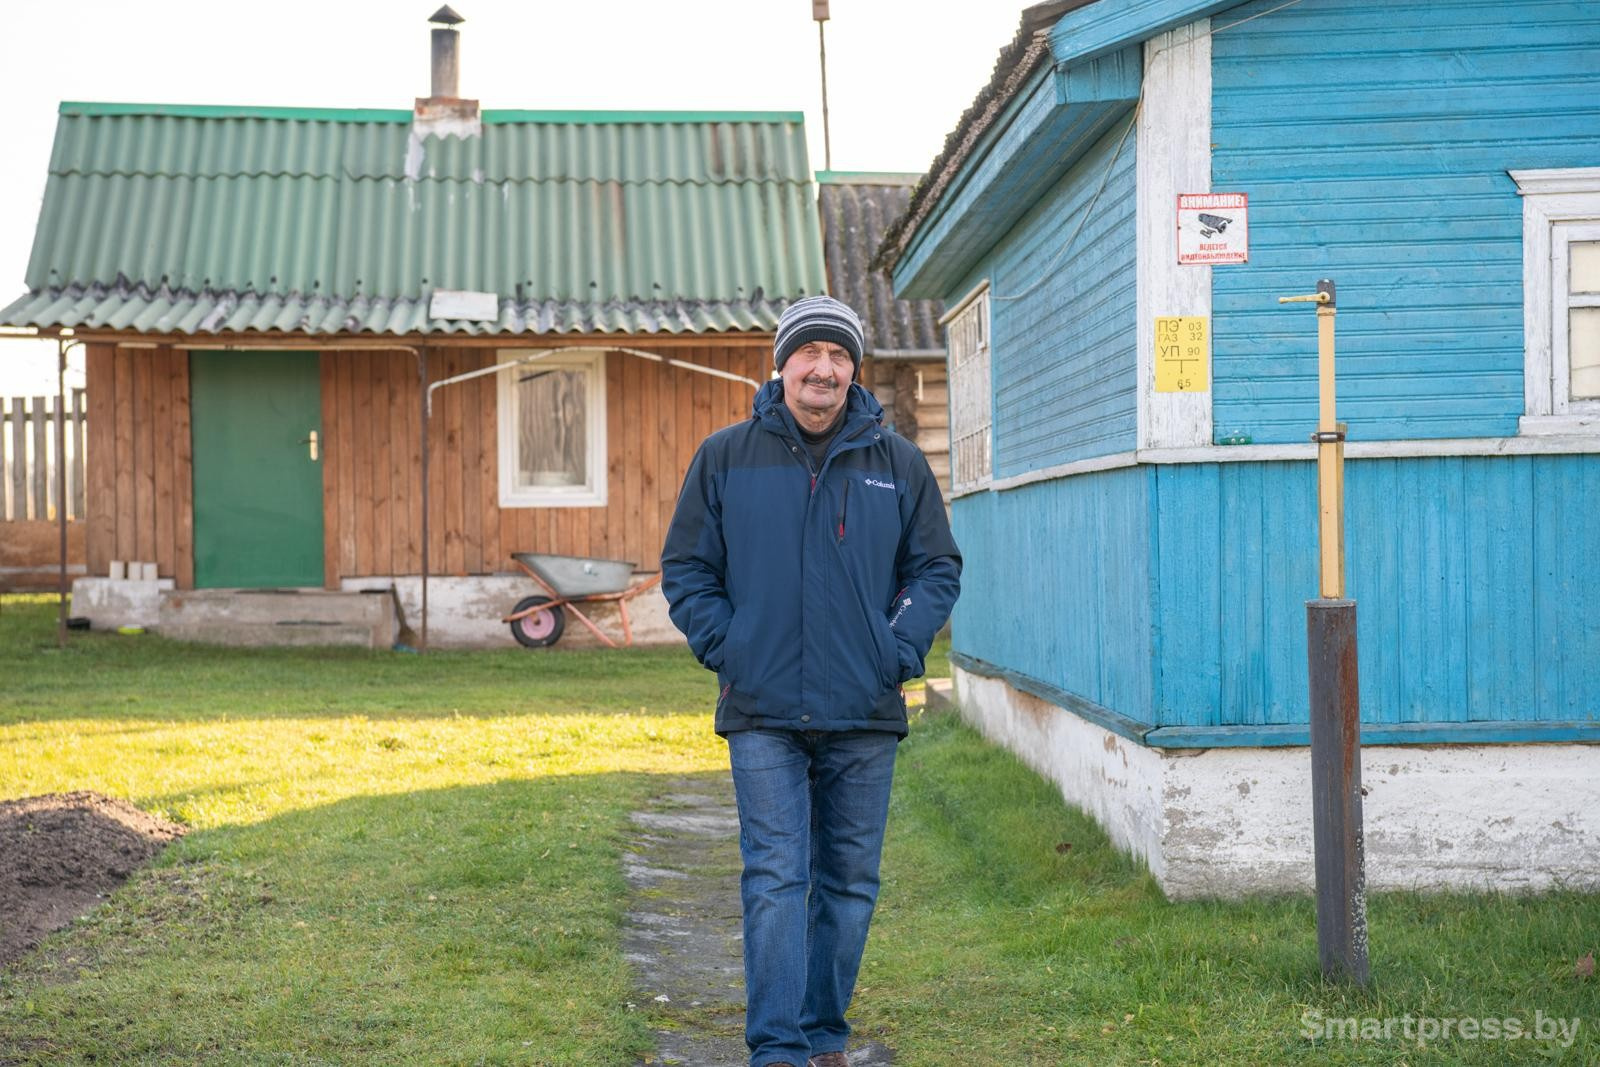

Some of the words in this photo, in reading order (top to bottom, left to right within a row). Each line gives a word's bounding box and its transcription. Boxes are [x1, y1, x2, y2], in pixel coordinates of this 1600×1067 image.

[1158, 319, 1179, 333] ПЭ
[1188, 322, 1202, 331] 03
[1158, 333, 1178, 343] ГАЗ
[1190, 332, 1203, 341] 32
[1160, 345, 1180, 358] УП
[1187, 347, 1200, 356] 90
